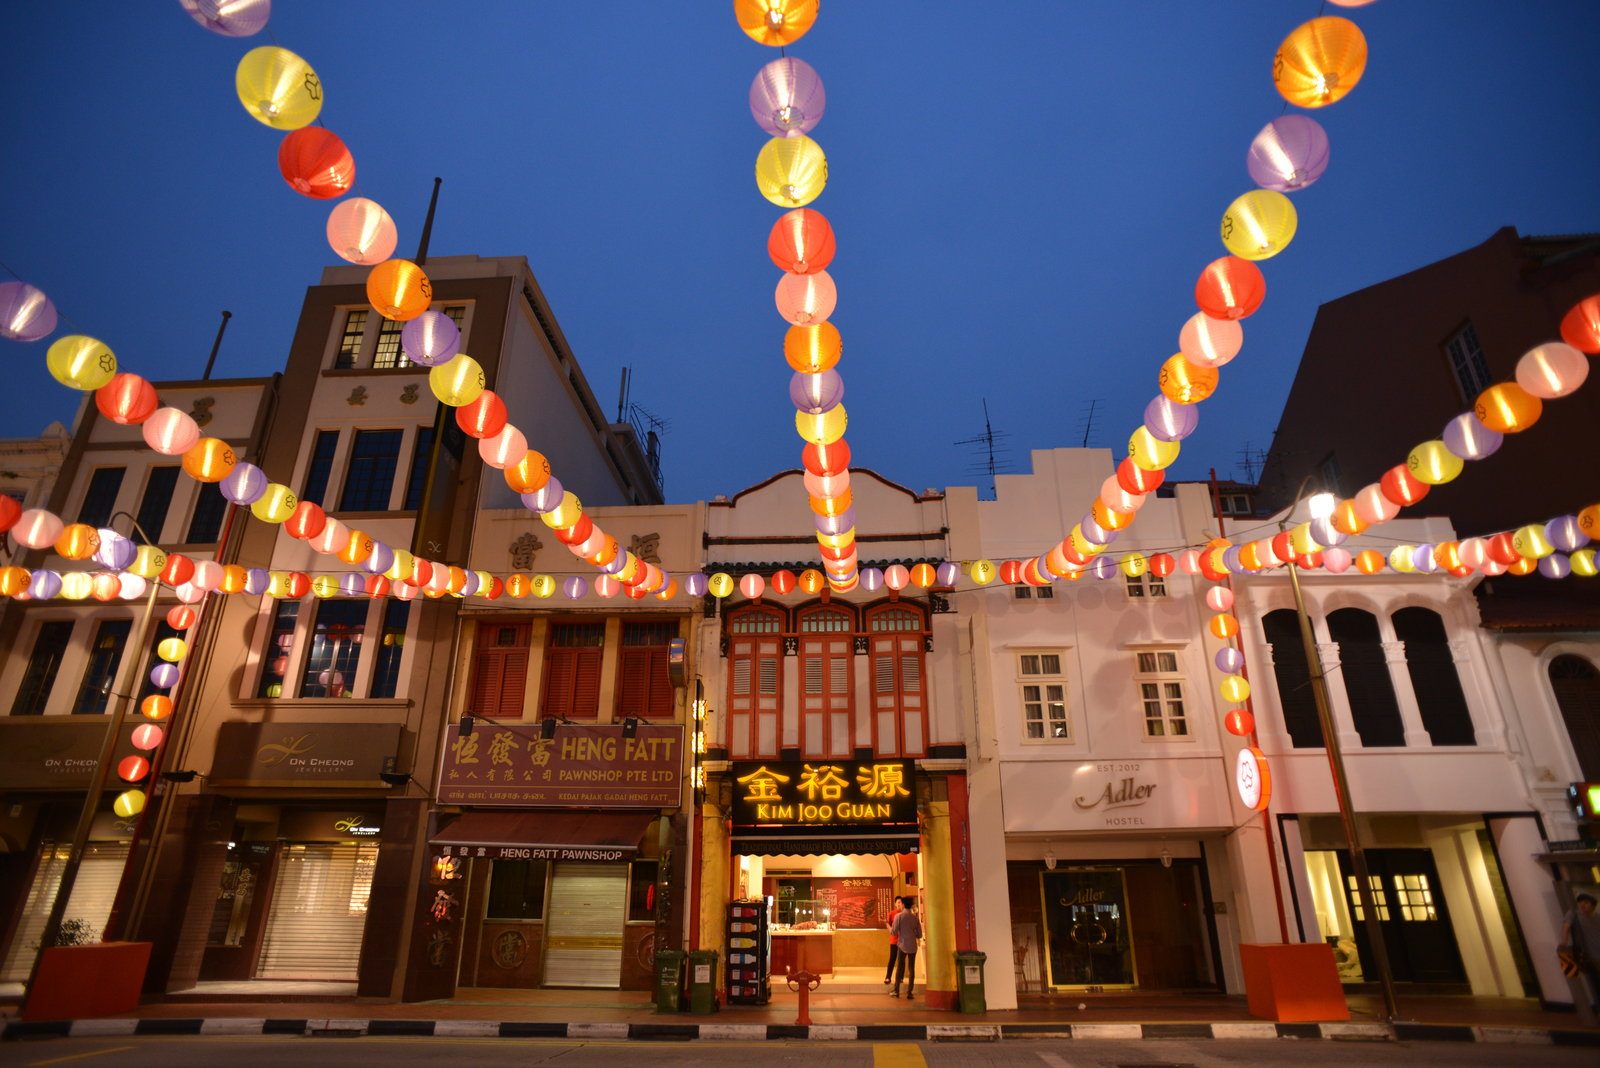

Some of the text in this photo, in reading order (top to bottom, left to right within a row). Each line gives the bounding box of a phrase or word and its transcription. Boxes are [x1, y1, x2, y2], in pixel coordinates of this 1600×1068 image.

[561, 737, 676, 761] HENG FATT
[65, 759, 99, 767] CHEON
[448, 769, 553, 782] 私人有限公司
[559, 770, 674, 782] PAWNSHOP PTE LTD
[737, 763, 911, 801] 金裕源
[558, 792, 669, 801] KEDAI PAJAK GADAI HENG FATT
[1074, 777, 1157, 810] Adler
[757, 802, 891, 822] KIM JOO GUAN
[1105, 817, 1145, 826] HOSTEL
[500, 848, 623, 861] HENG FATT PAWNSHOP
